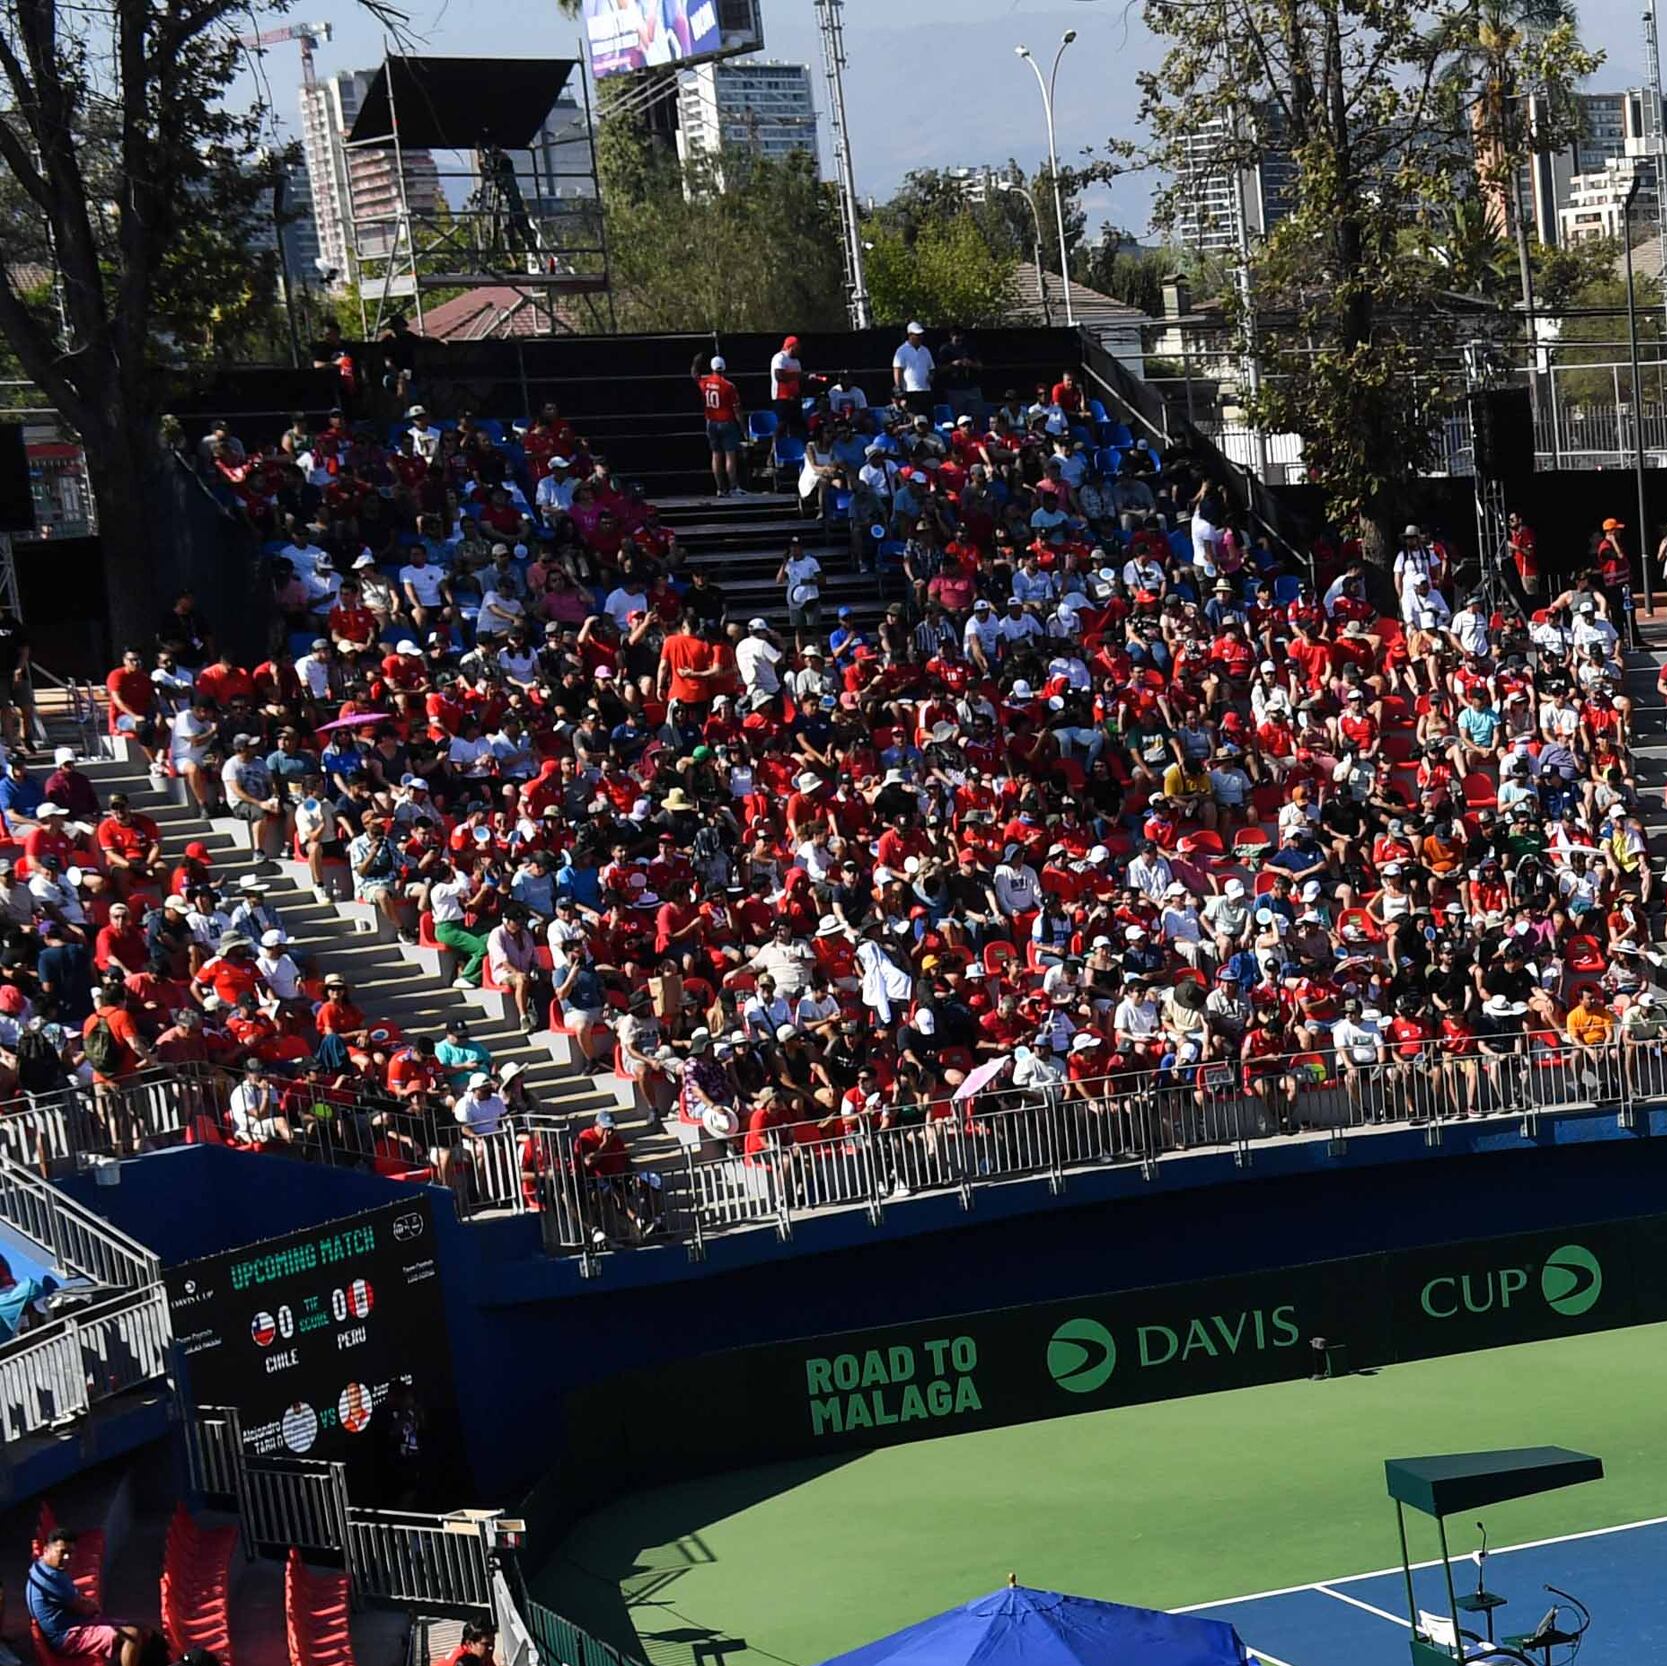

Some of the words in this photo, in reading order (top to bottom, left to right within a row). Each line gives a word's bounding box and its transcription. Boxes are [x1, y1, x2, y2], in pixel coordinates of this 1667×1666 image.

[230, 1243, 317, 1290] UPCOMING
[320, 1225, 375, 1264] MATCH
[1420, 1268, 1528, 1318] CUP
[265, 1349, 299, 1374] CHILE
[337, 1326, 366, 1350] PERU
[806, 1346, 915, 1395] ROAD
[924, 1336, 978, 1373] TO
[1137, 1305, 1299, 1367] DAVIS
[810, 1376, 983, 1436] MALAGA
